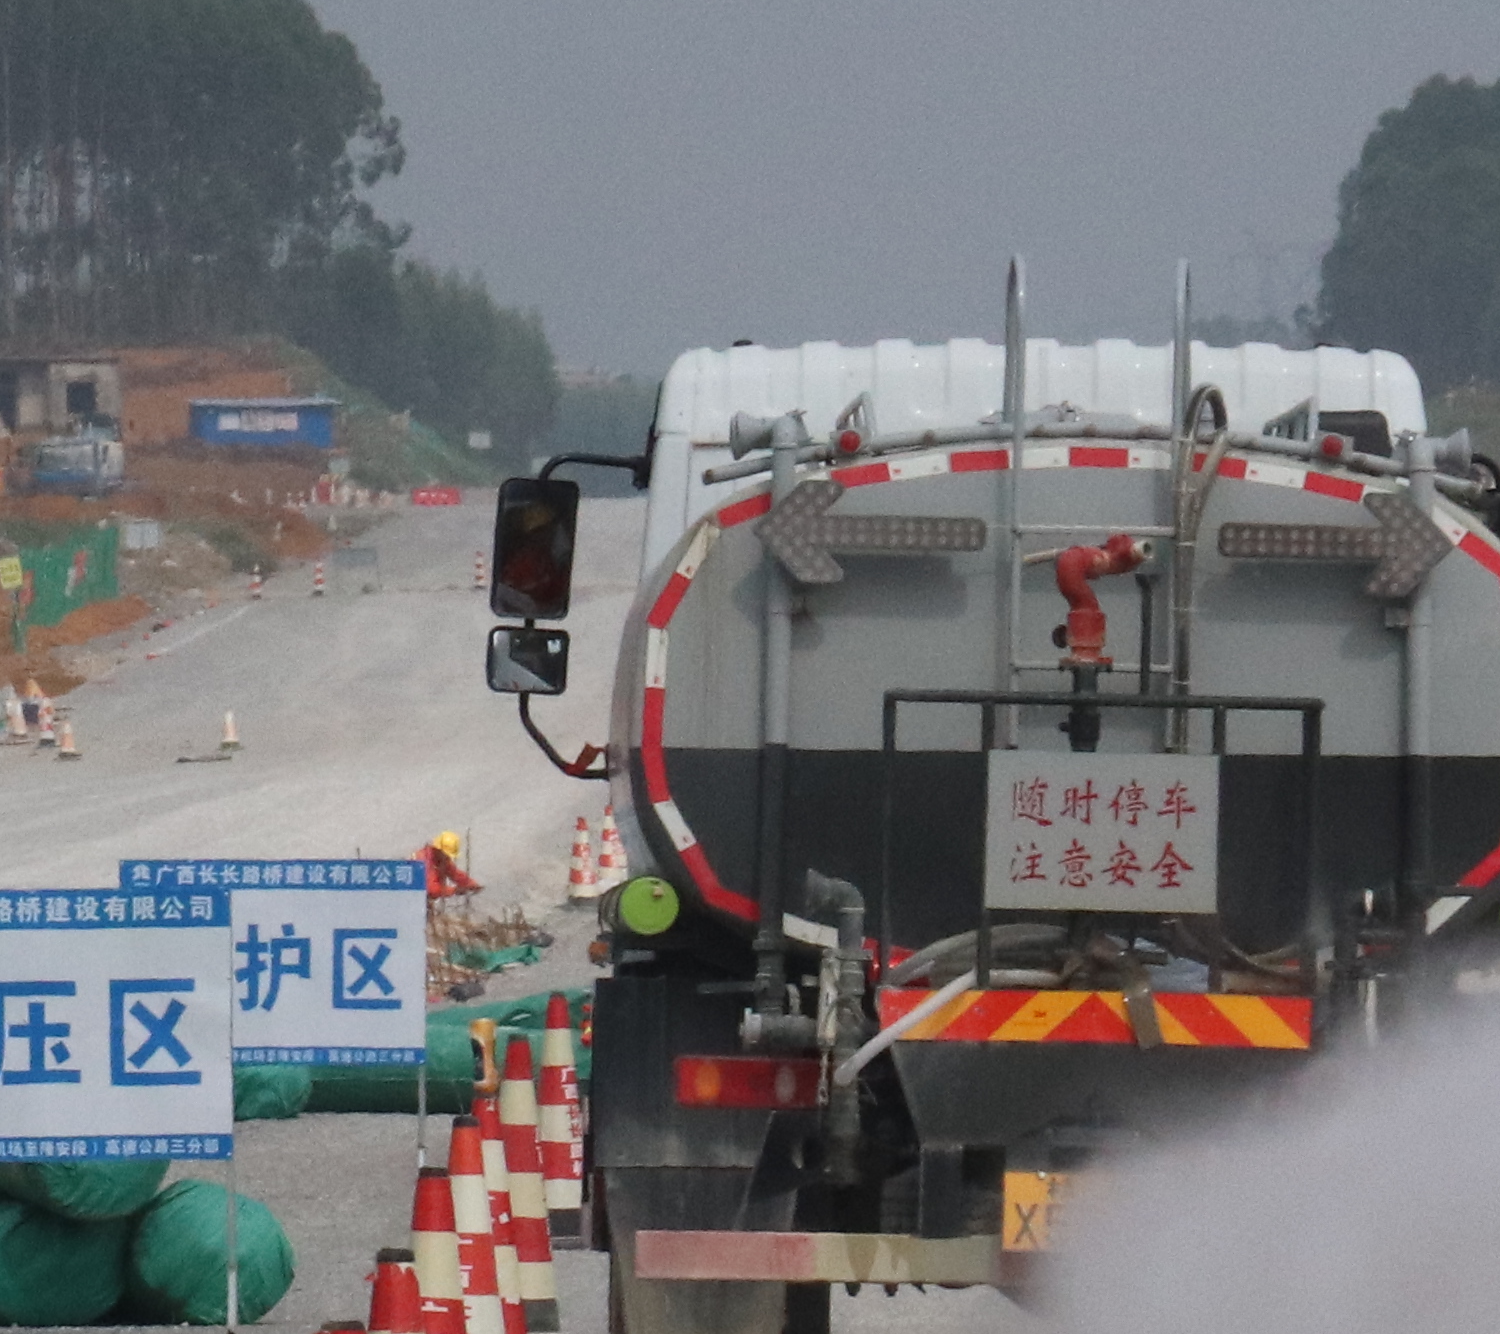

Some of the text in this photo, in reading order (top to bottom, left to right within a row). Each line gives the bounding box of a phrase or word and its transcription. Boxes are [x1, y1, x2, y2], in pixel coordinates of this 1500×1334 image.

[1012, 776, 1197, 829] 随时停车
[156, 863, 413, 886] 广西长长路桥建设有限公司
[1010, 838, 1194, 888] 注意安全
[235, 923, 402, 1011] 护区
